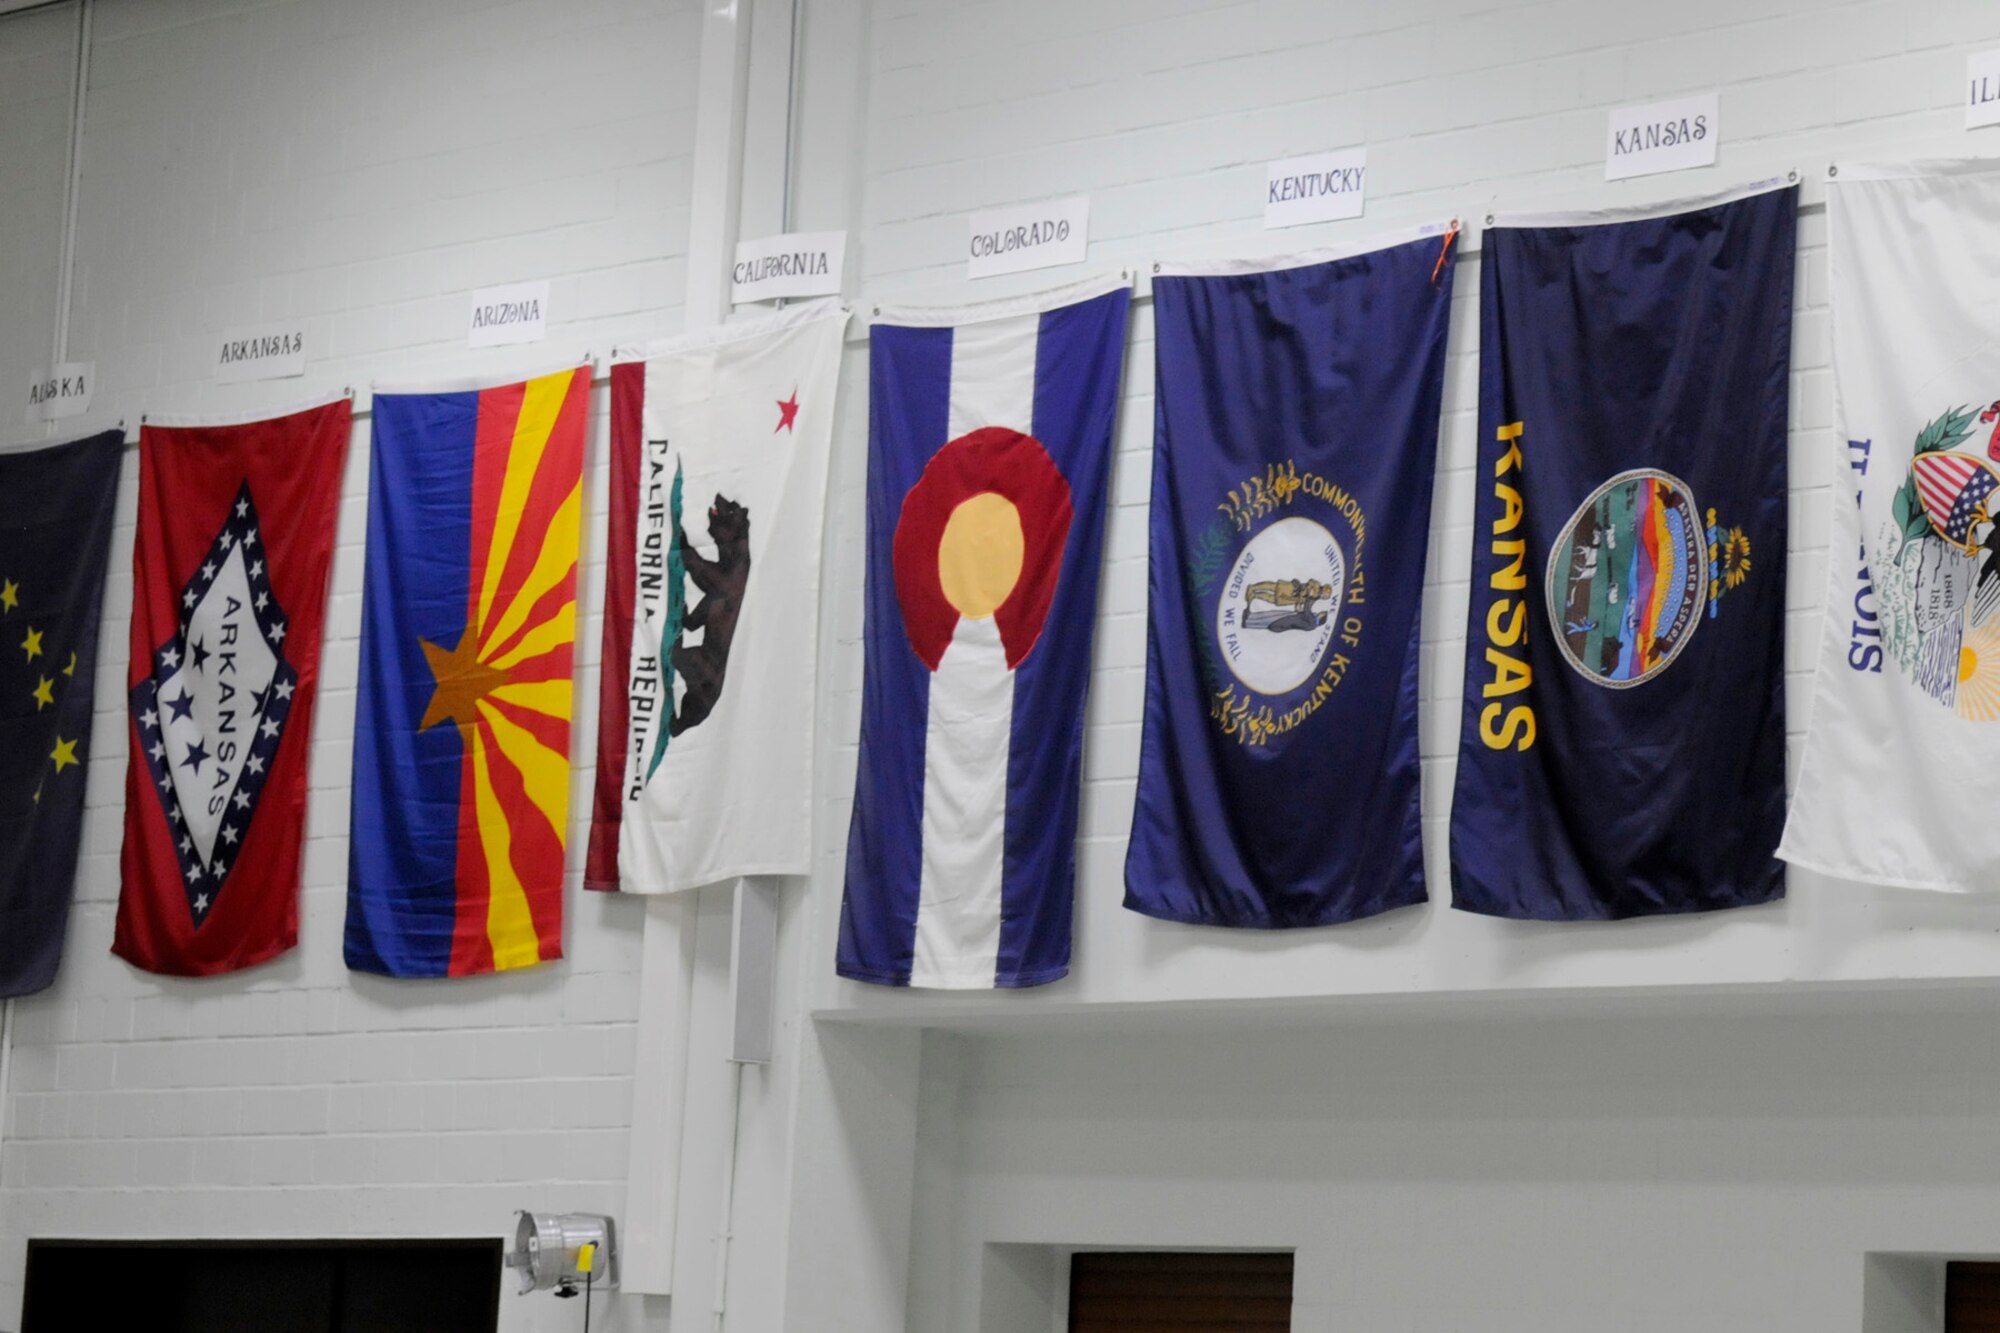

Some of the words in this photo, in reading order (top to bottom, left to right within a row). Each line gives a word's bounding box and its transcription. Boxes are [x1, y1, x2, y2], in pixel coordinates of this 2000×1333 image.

[1971, 74, 2000, 105] IL
[1614, 115, 1707, 155] KANSAS
[1268, 166, 1365, 204] KENTUCKY
[971, 219, 1070, 258] COLORADO
[733, 252, 828, 284] CALIFORNIA
[472, 299, 540, 328] ARIZONA
[220, 332, 302, 364] ARKANSAS
[1302, 472, 1365, 603] COMMONWTH
[1228, 552, 1255, 599] DIVIDED
[1479, 420, 1537, 752] KANSAS
[1224, 608, 1236, 627] WE
[1928, 589, 1940, 620] 1818
[1225, 633, 1242, 662] FALL
[1341, 617, 1362, 648] OF
[208, 596, 242, 816] ARKANSAS
[1275, 653, 1351, 736] KENTUCKY
[628, 656, 657, 801] REPUC
